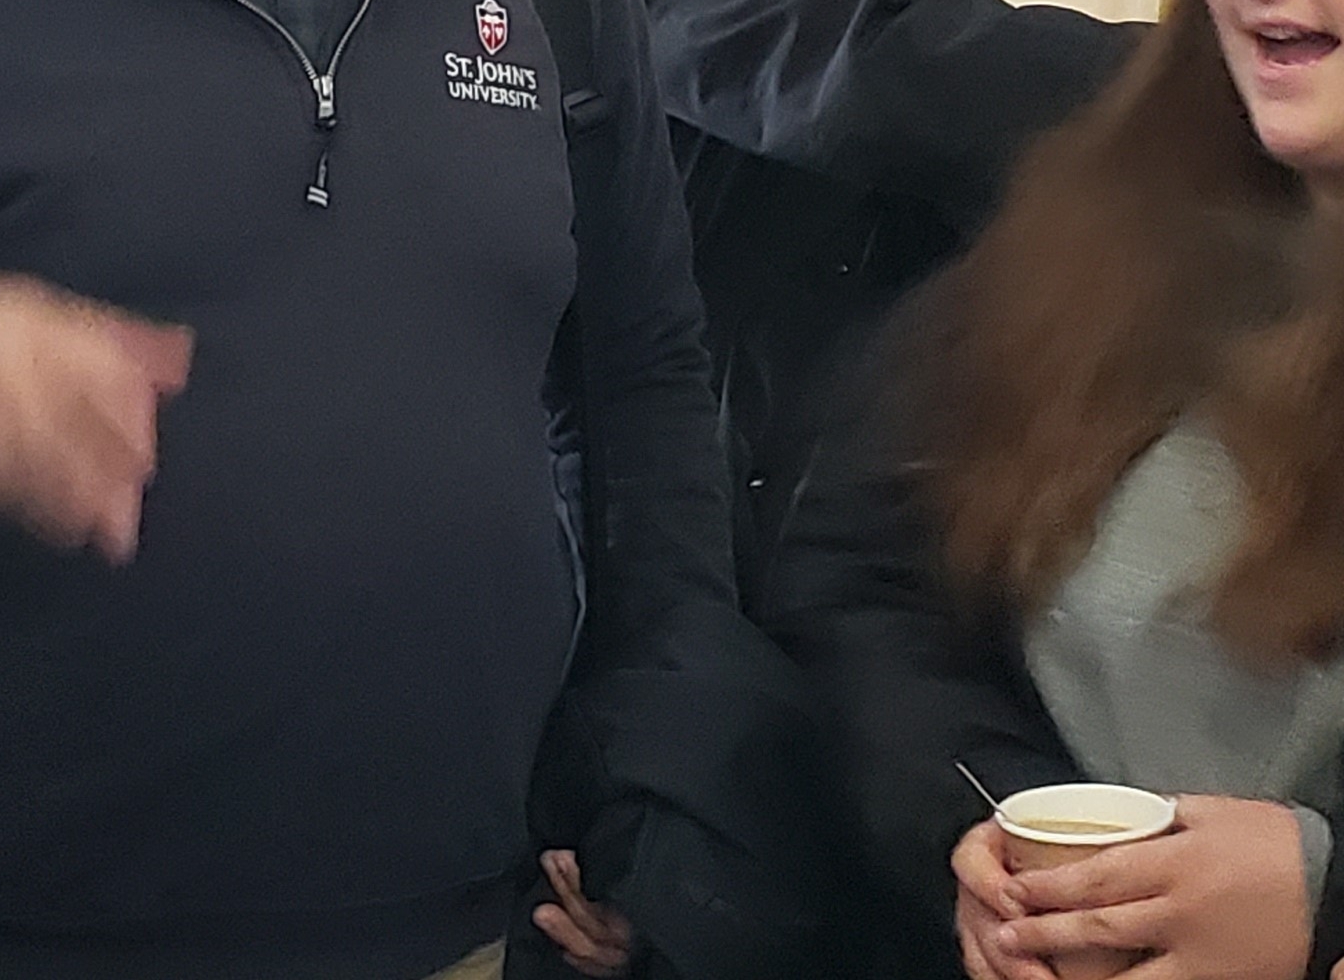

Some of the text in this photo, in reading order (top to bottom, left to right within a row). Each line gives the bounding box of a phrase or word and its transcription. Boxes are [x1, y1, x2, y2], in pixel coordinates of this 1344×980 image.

[444, 52, 537, 90] ST. JOHN'S
[448, 81, 537, 111] UNIVERSITY
